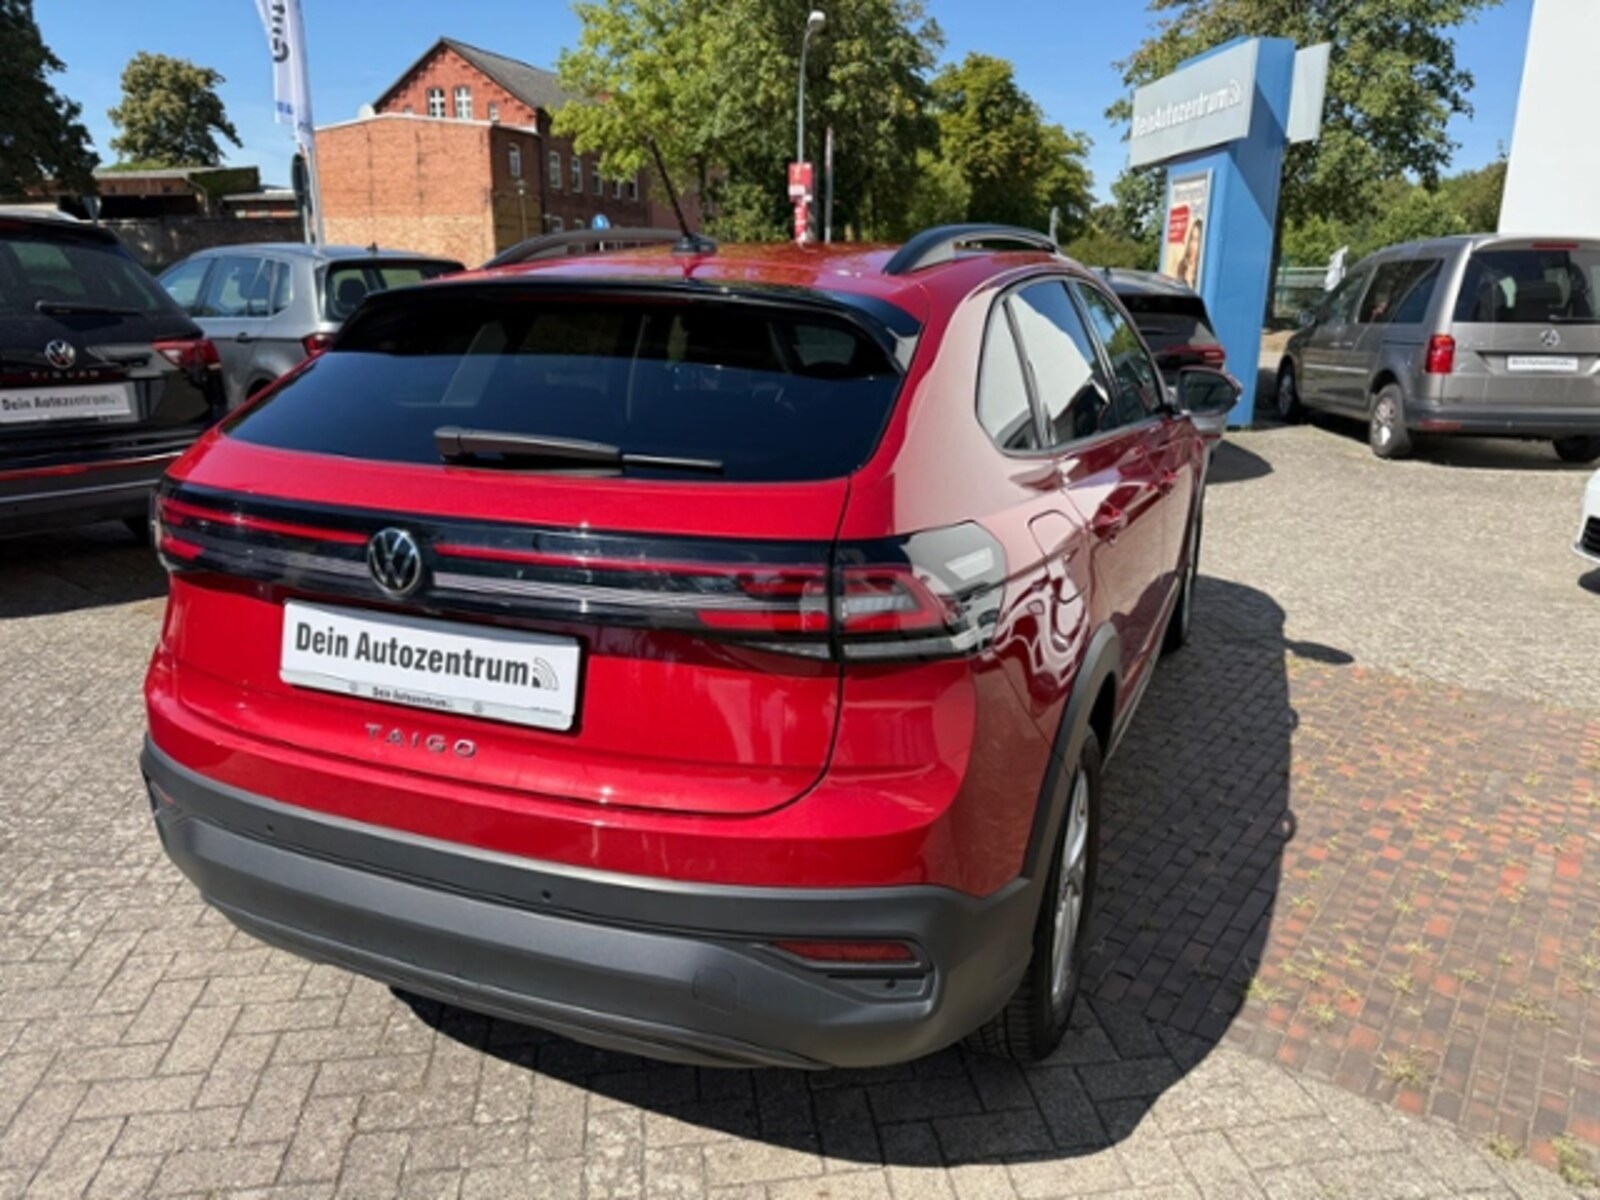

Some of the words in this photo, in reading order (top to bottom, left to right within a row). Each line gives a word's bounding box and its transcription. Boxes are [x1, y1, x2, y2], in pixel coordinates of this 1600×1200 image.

[295, 621, 349, 659] Dein
[354, 631, 529, 689] Autozentrum
[364, 722, 478, 758] TAIGO
